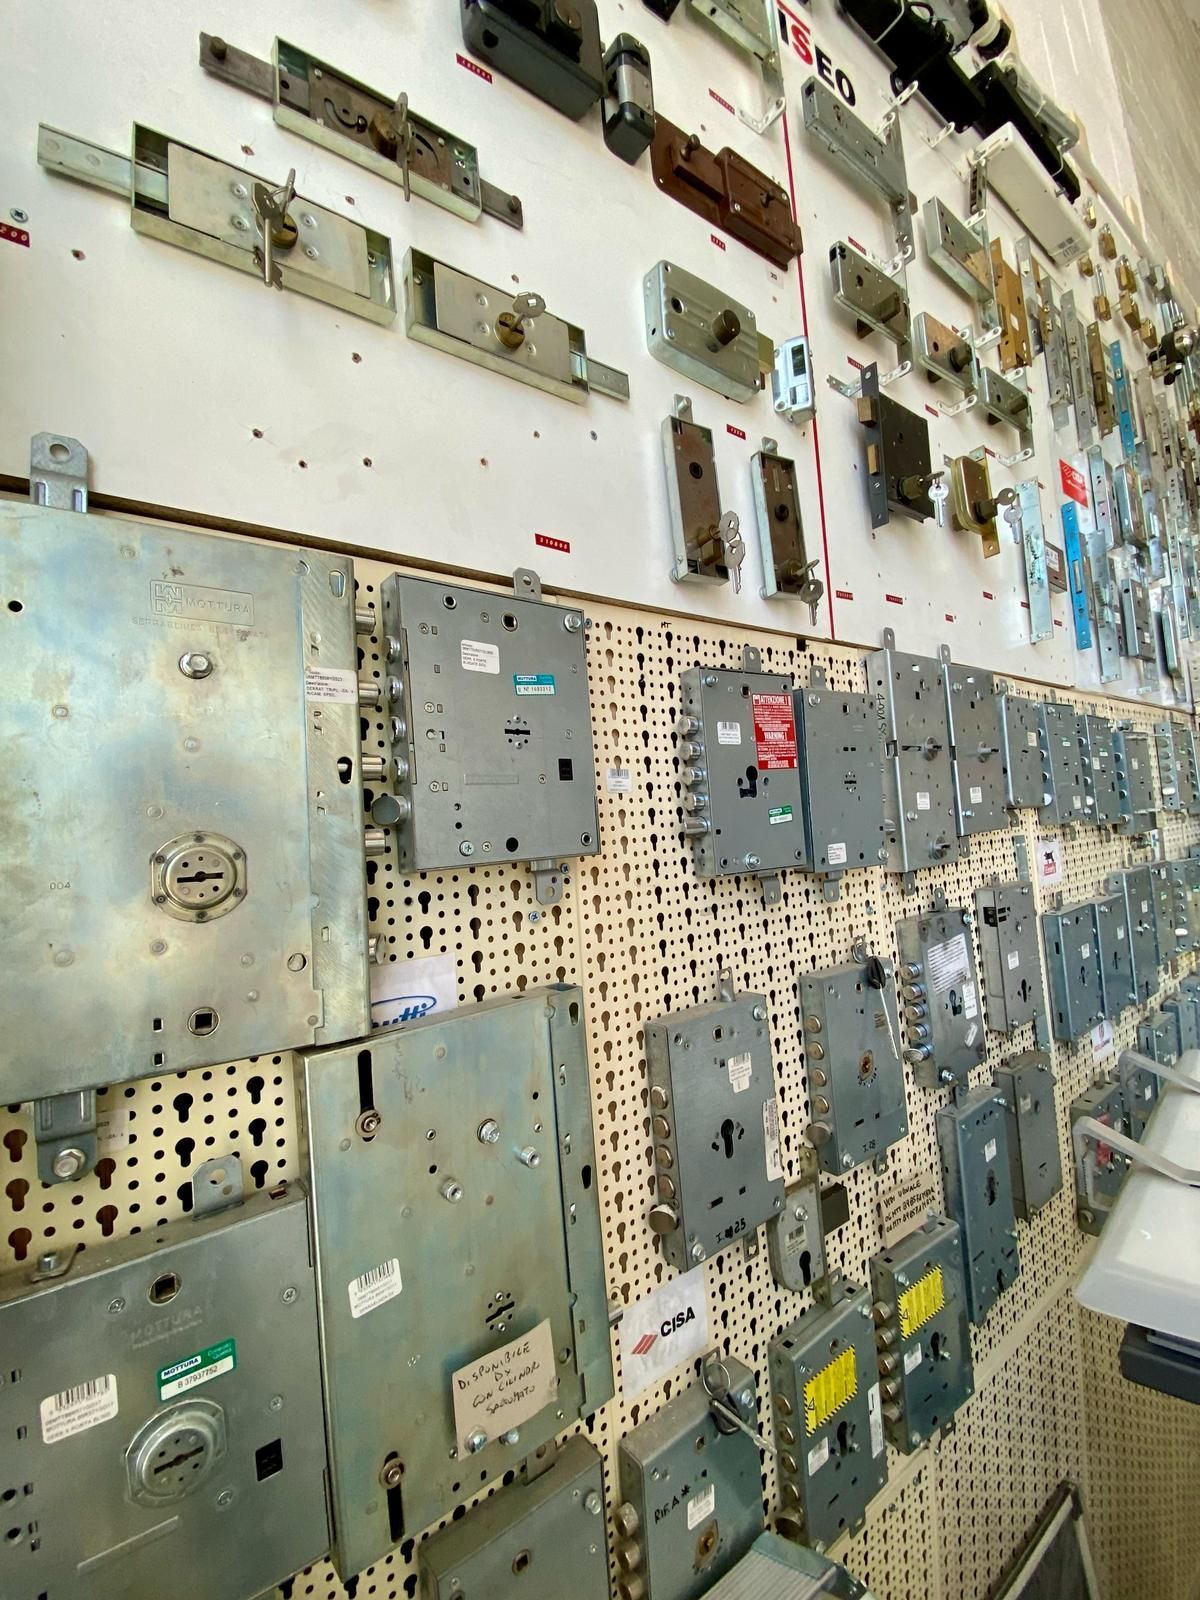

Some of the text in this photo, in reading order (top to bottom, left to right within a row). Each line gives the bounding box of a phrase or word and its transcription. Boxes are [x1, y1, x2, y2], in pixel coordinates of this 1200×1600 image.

[778, 9, 855, 107] ISEO
[660, 1306, 696, 1337] CISA
[163, 1358, 198, 1377] MOTTURA
